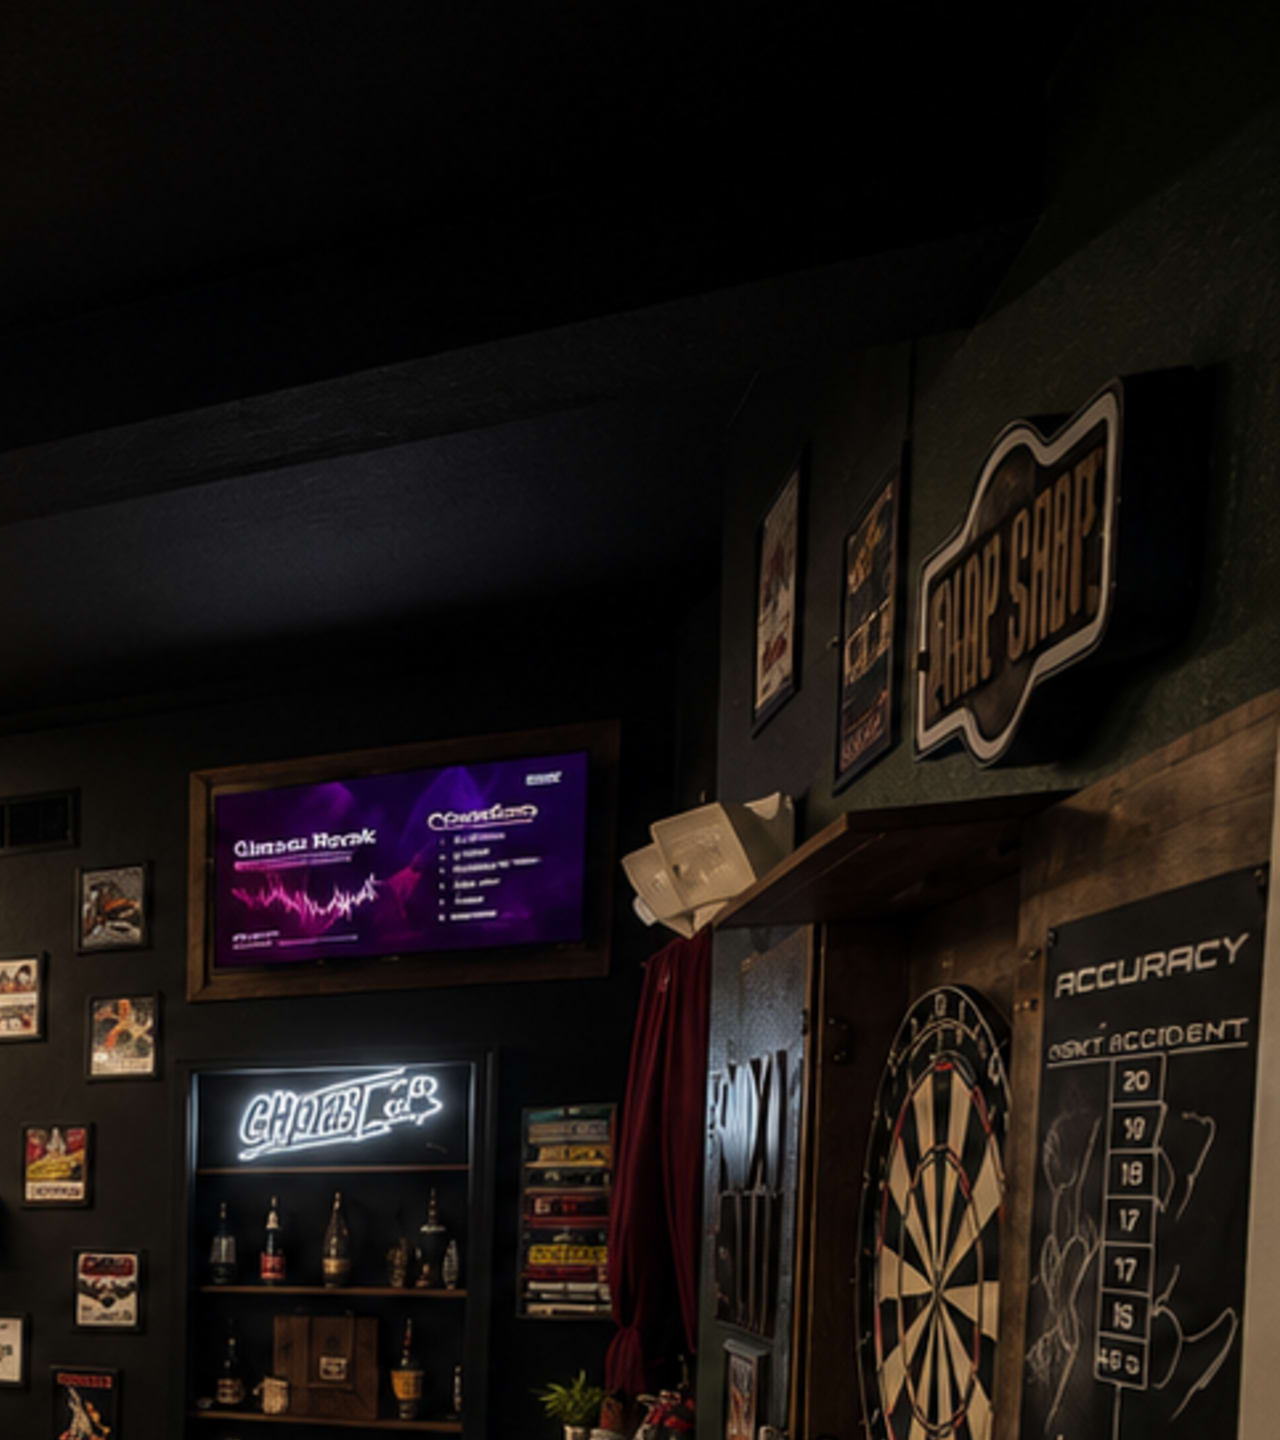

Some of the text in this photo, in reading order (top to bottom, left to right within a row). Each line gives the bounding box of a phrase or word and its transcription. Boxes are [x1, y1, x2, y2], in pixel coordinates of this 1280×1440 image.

[1054, 932, 1250, 998] ACCURACY
[1109, 1018, 1249, 1053] ACCIDENT
[1122, 1070, 1151, 1092] 20
[1121, 1160, 1144, 1187] 18
